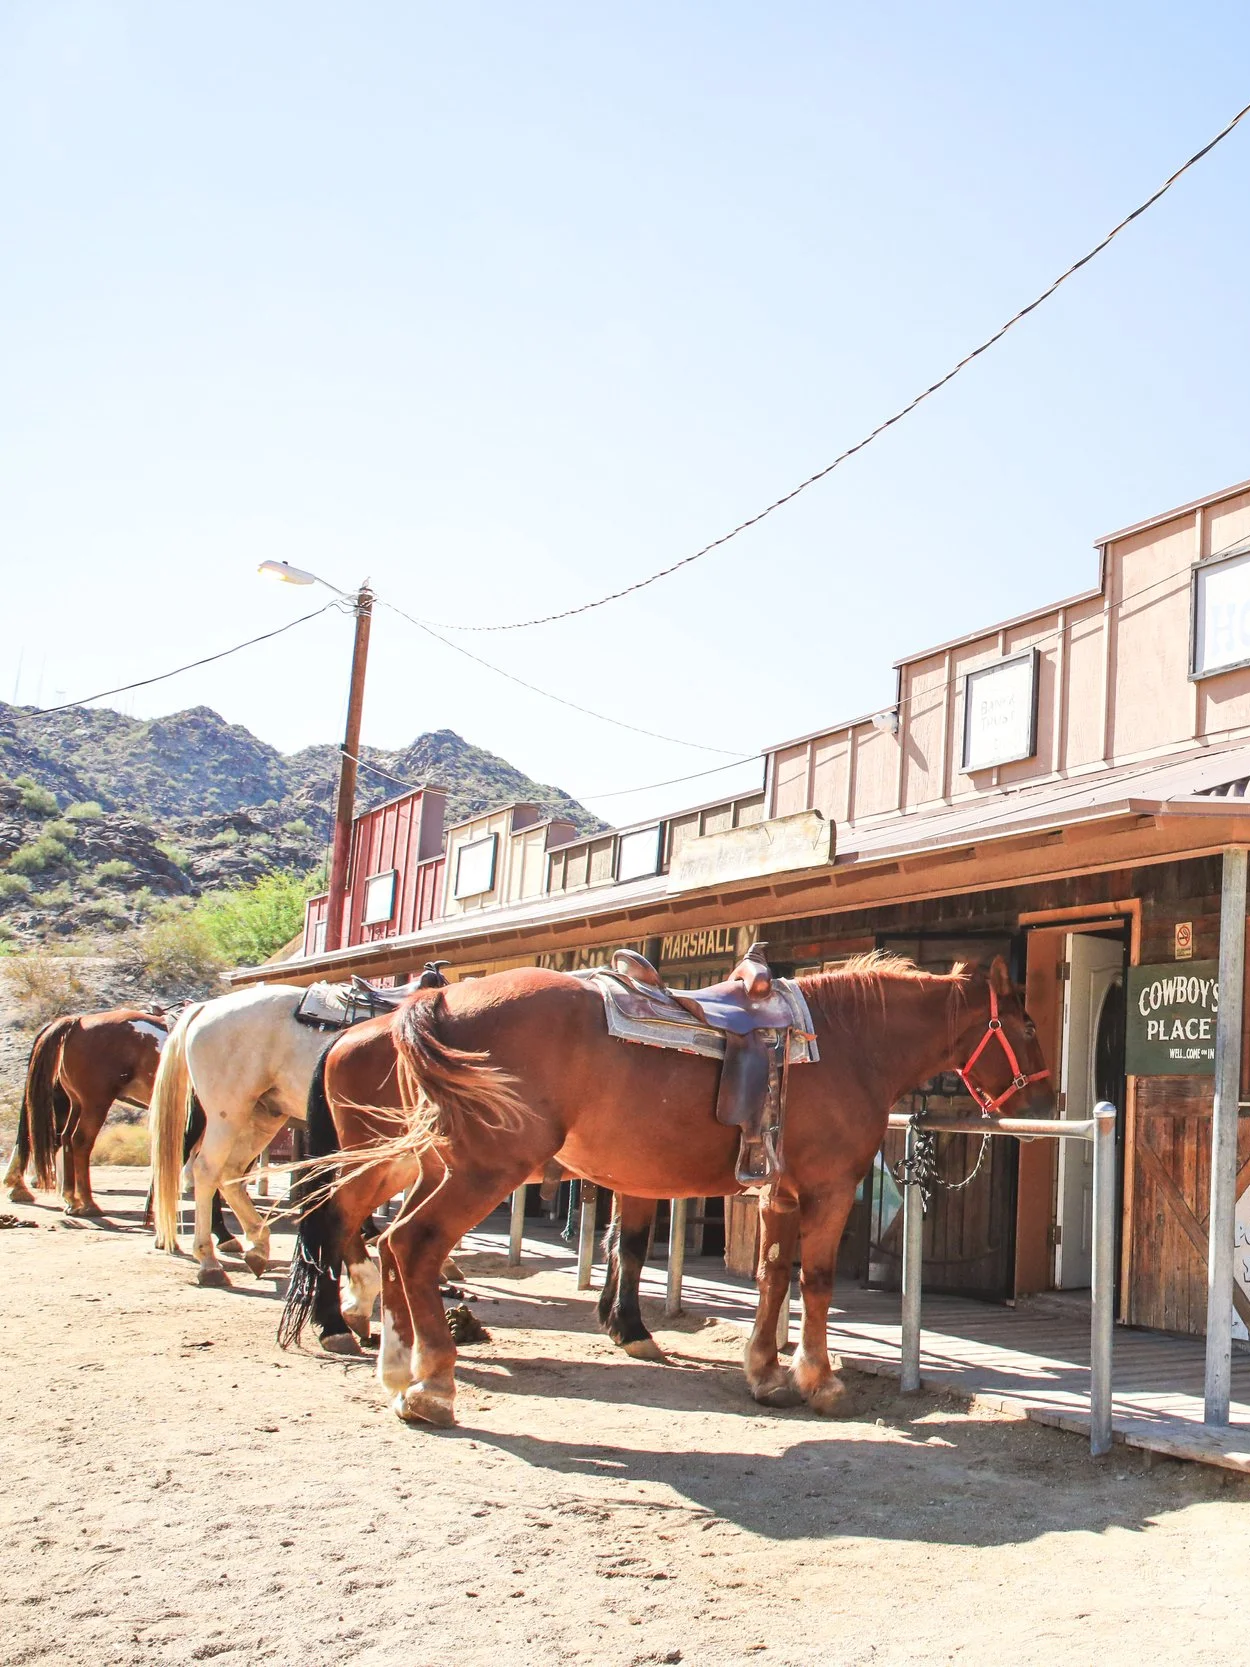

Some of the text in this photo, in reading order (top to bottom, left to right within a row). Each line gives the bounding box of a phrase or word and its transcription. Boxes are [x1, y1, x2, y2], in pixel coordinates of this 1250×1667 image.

[660, 927, 734, 961] MARSHALL
[1138, 976, 1219, 1016] COWBOY'S
[1147, 1018, 1212, 1041] PLACE
[1208, 1048, 1215, 1060] IN
